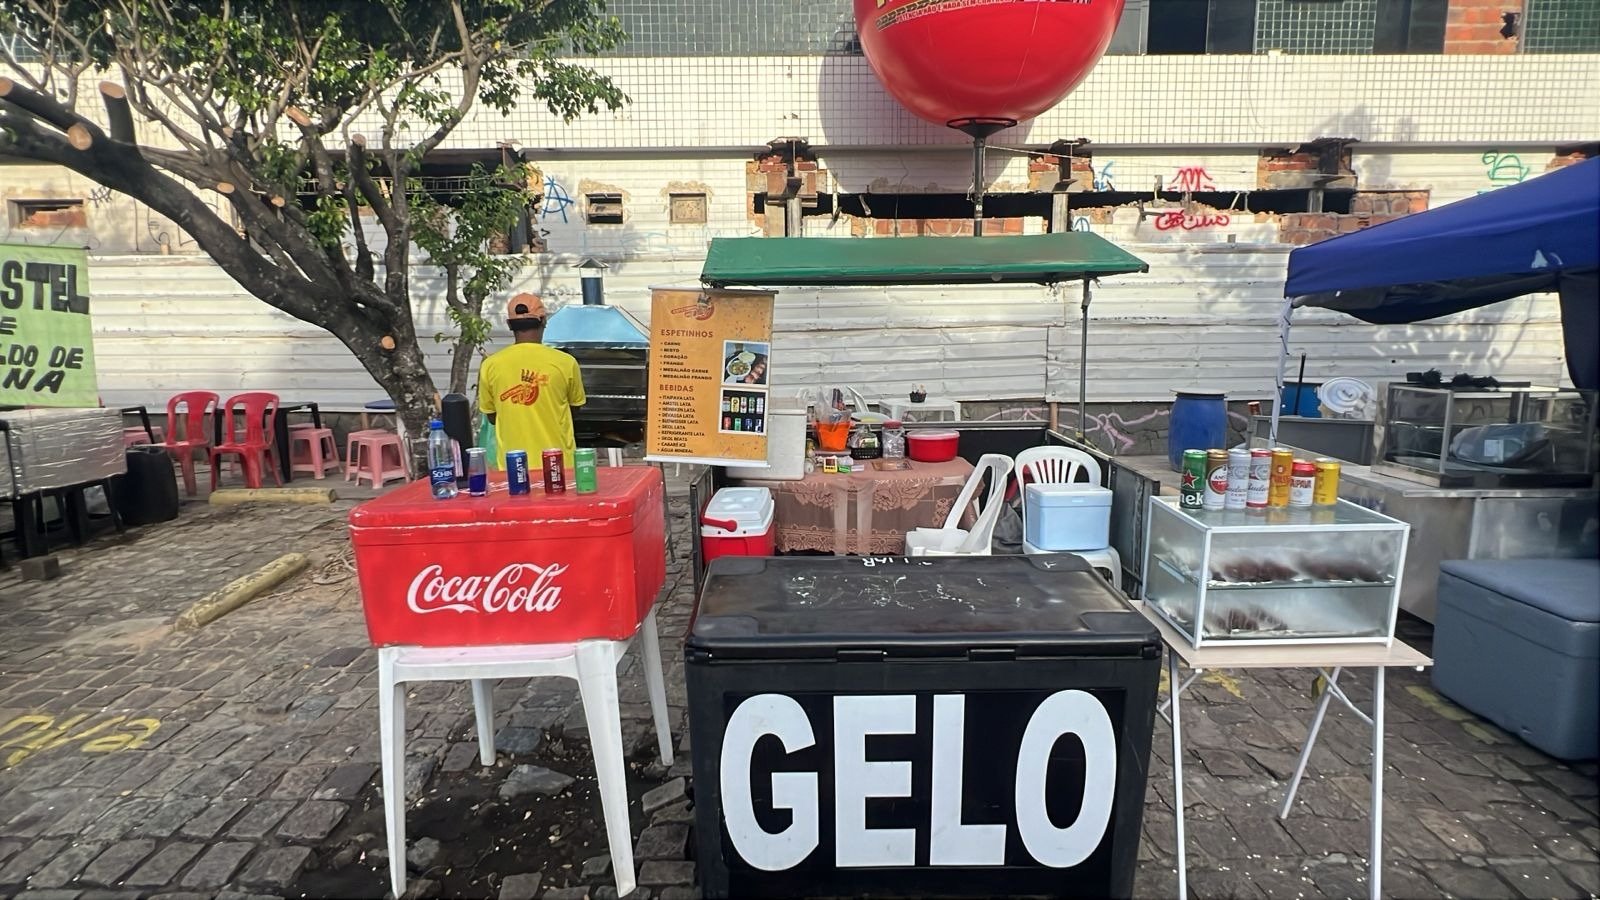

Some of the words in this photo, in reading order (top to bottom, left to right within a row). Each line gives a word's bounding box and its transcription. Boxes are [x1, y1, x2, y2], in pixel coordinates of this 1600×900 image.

[661, 329, 713, 338] ESPETINHOS
[48, 346, 84, 369] DE
[515, 457, 525, 483] BEATS
[550, 456, 558, 482] BEATS
[407, 563, 569, 613] Coca-Cola
[720, 689, 1117, 872] GELO
